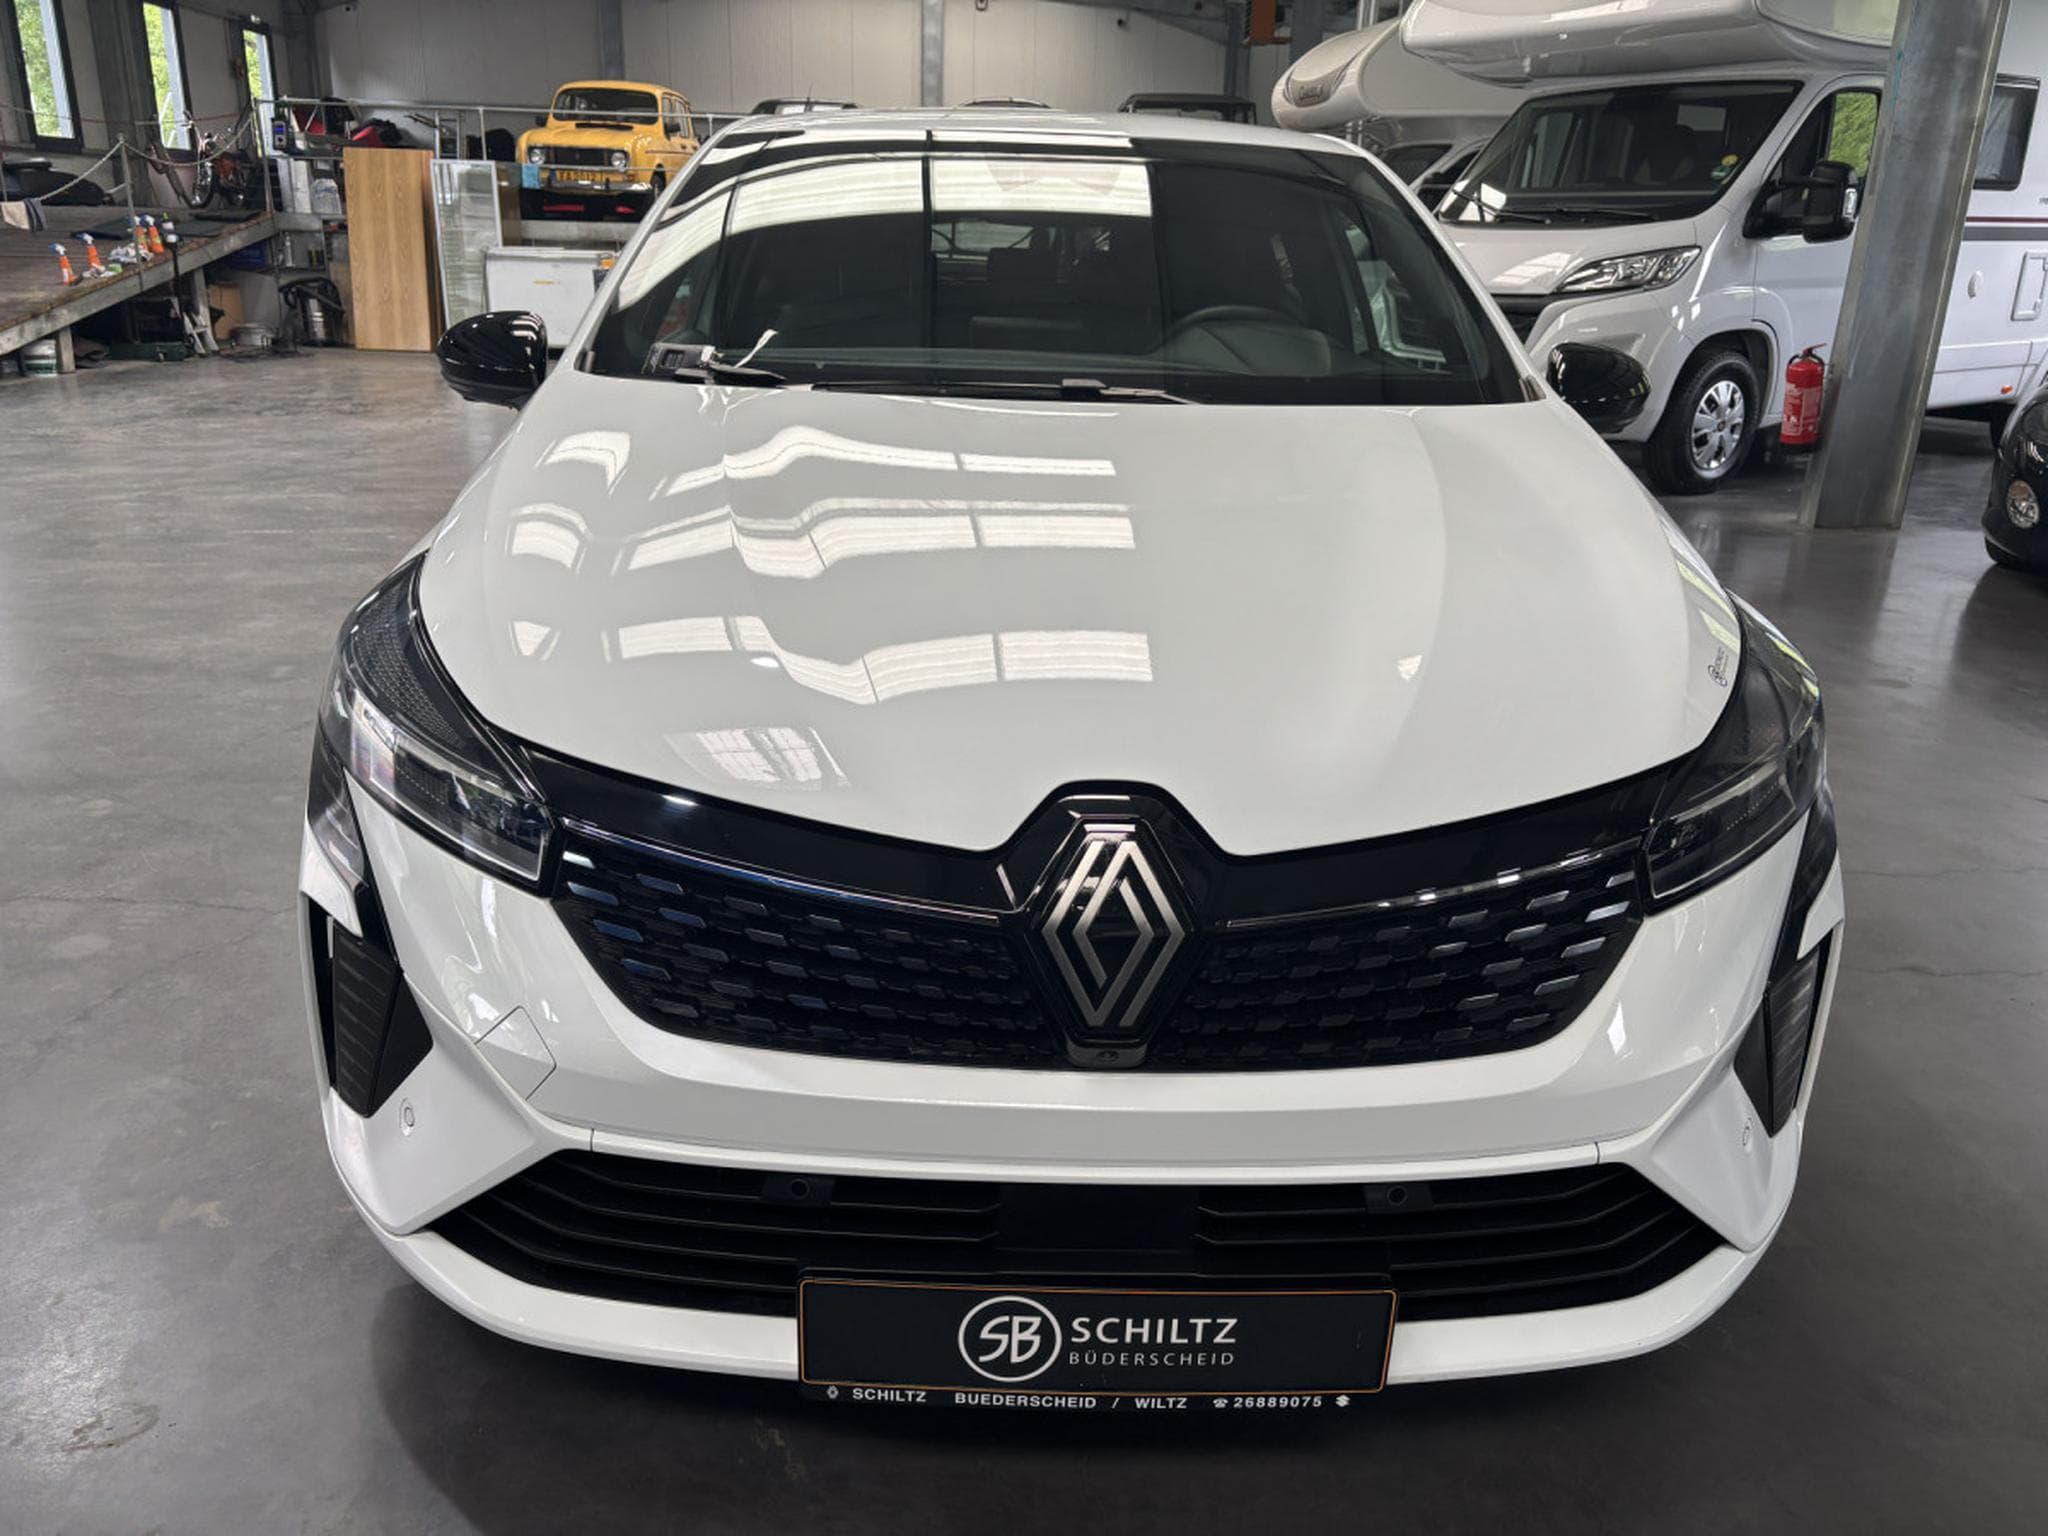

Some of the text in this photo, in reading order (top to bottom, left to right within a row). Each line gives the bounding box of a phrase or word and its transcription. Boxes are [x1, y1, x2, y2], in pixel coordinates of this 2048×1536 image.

[978, 1315, 1042, 1364] SB
[1071, 1317, 1238, 1344] SCHILTZ
[1069, 1350, 1234, 1366] BÜDERSCHEID
[852, 1388, 927, 1403] SCHILTZ
[954, 1392, 1097, 1409] BUEDERSCHEID
[1134, 1397, 1188, 1409] WILTZ
[1233, 1395, 1323, 1408] 26889075
